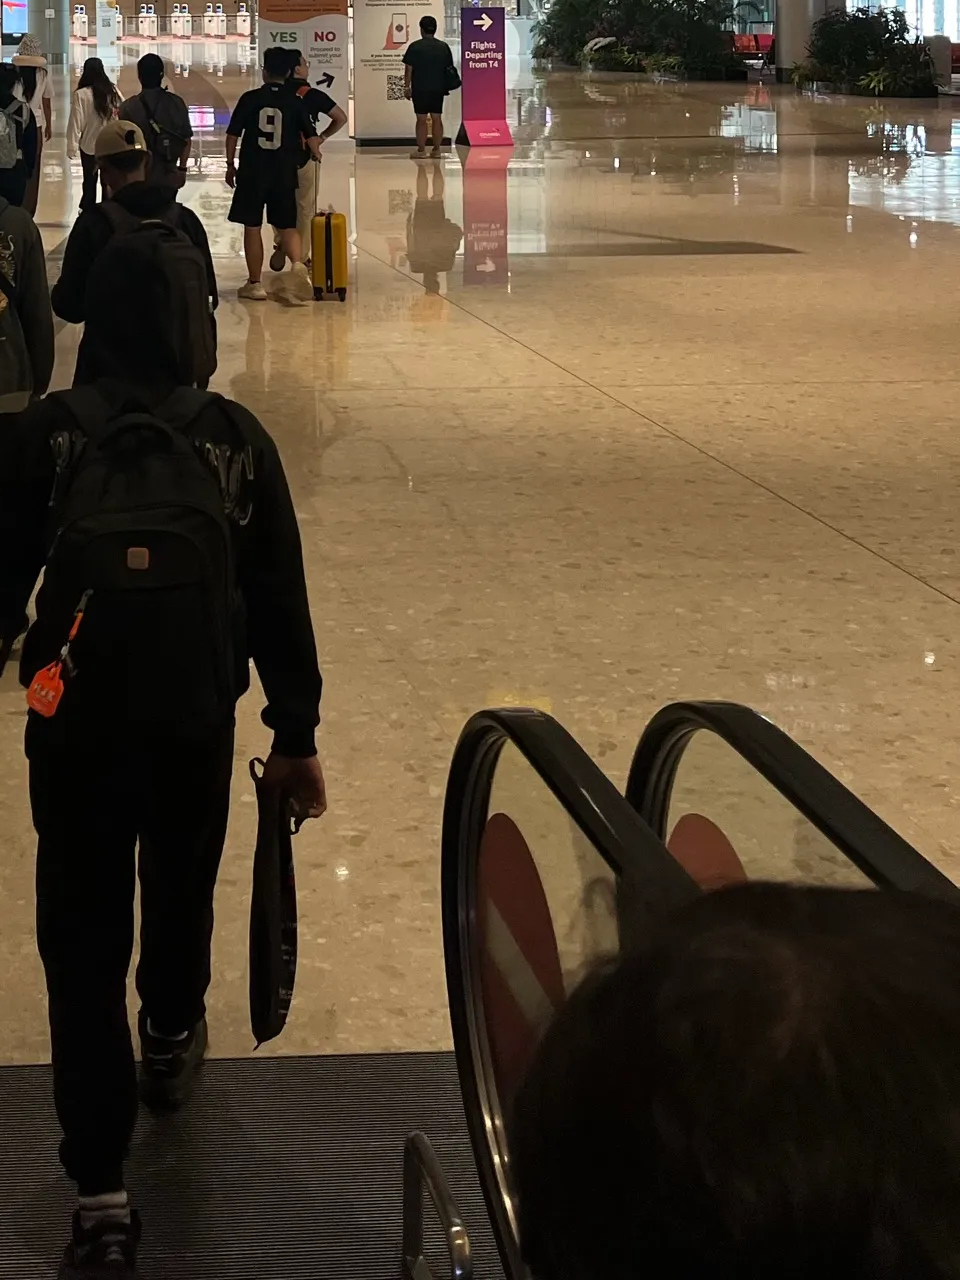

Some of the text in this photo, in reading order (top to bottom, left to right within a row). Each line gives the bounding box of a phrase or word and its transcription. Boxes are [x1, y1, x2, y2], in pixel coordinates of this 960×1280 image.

[269, 32, 297, 43] YES
[314, 31, 336, 42] NO
[471, 41, 496, 50] Flights
[465, 51, 502, 60] Departing
[469, 61, 488, 69] from
[257, 107, 283, 150] 9
